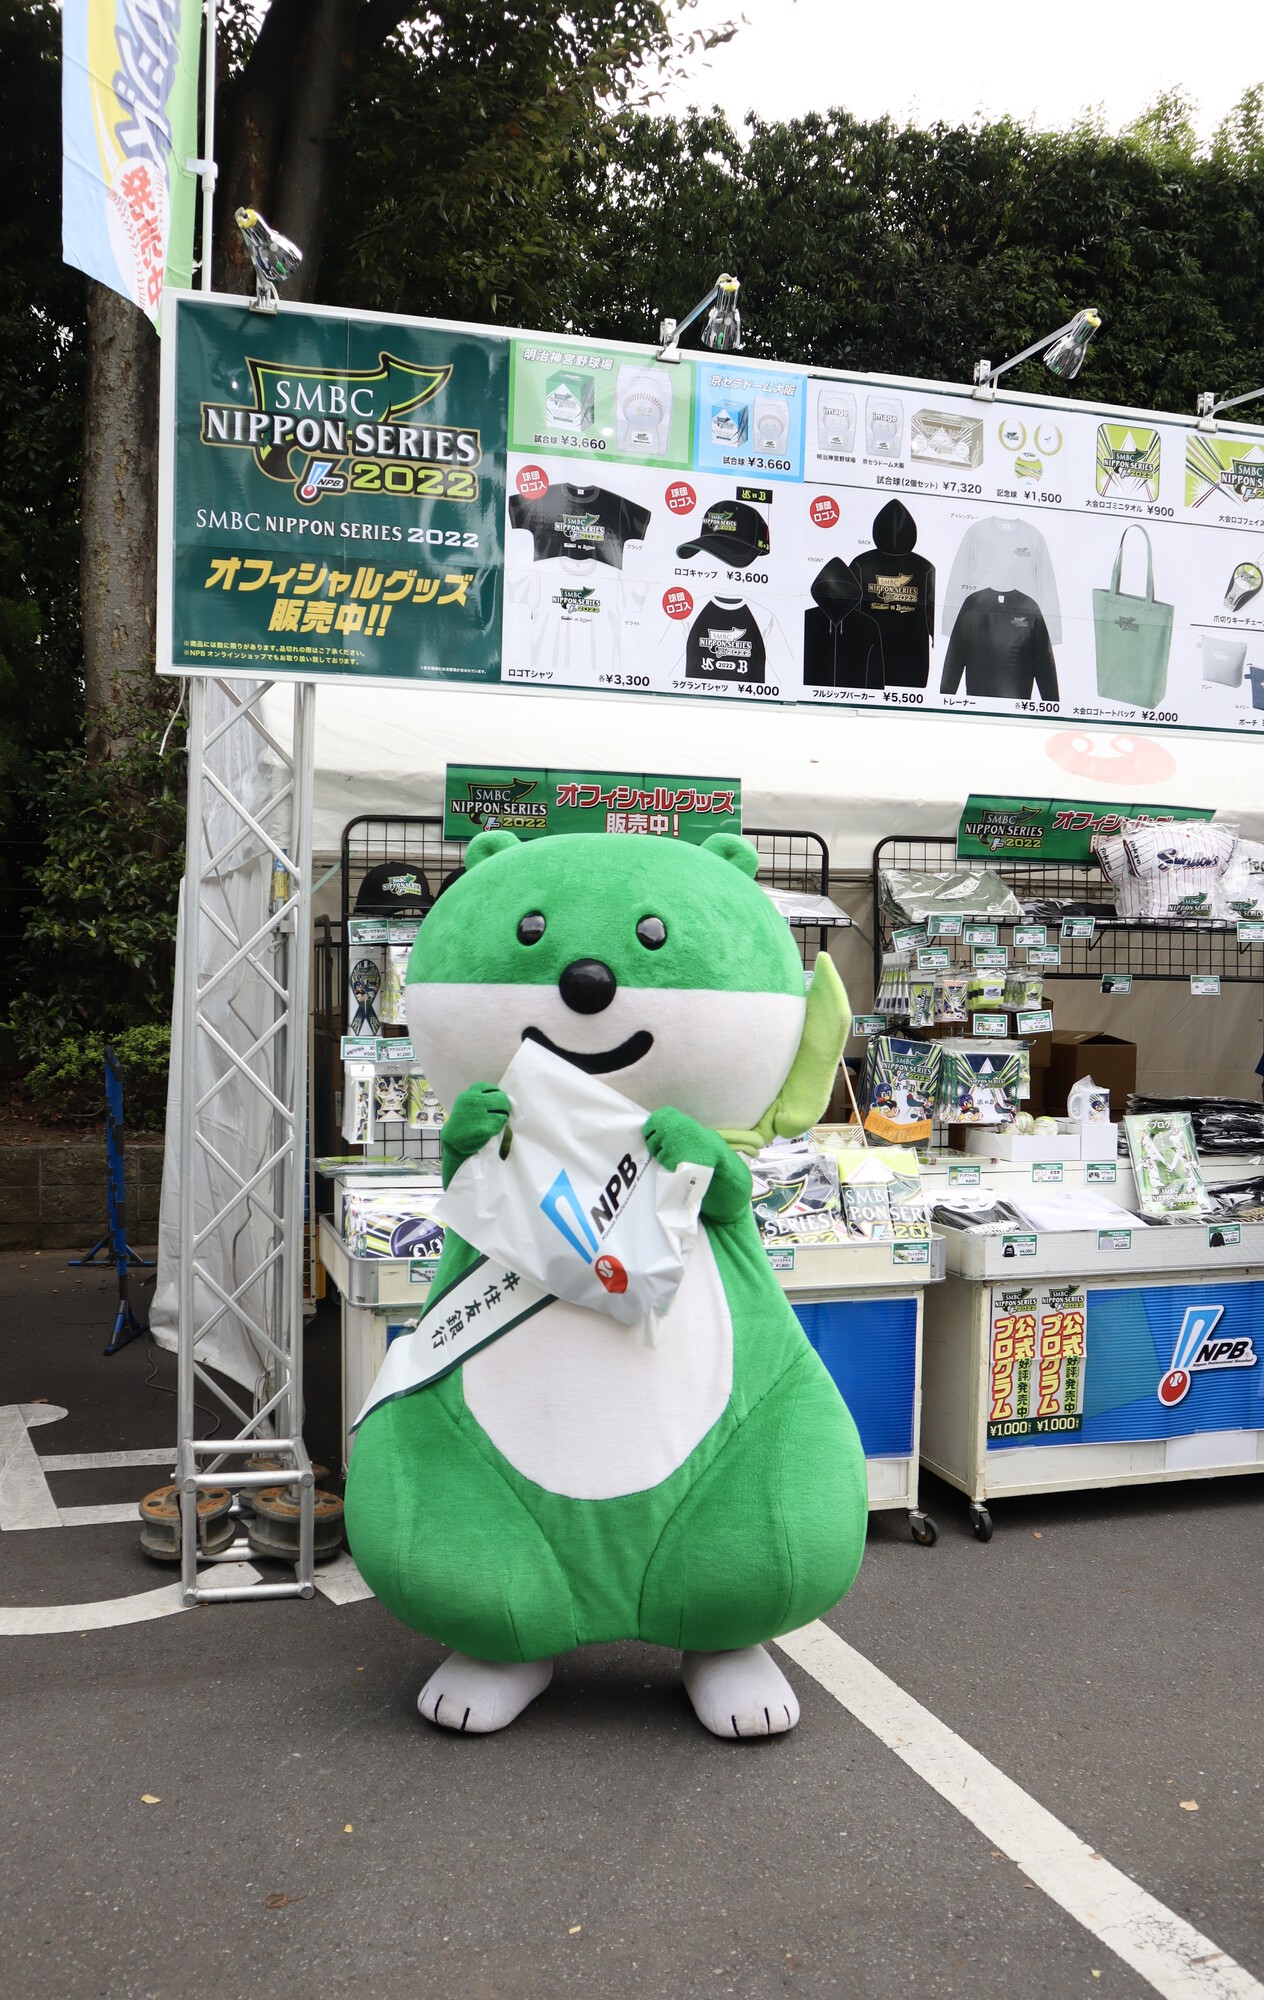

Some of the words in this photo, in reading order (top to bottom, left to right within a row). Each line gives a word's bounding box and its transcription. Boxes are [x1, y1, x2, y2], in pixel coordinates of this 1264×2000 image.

[523, 348, 614, 371] 明治神宮野球場
[710, 375, 797, 396] 京セラドーム大阪
[275, 381, 374, 417] SMBC
[207, 408, 345, 450] NIPPON
[355, 424, 475, 462] SERIES
[534, 434, 558, 444] 試合球
[561, 435, 606, 450] ¥3,660
[723, 456, 745, 466] 試合球
[748, 457, 791, 471] ¥3,660
[816, 454, 856, 463] 明治神宮野球場
[862, 458, 904, 469] 京セラドーム大阪
[1104, 458, 1130, 468] NIPPON
[1130, 462, 1153, 471] SERIES
[1116, 453, 1135, 461] SMBC
[521, 470, 540, 482] 球団
[1238, 464, 1263, 477] SMBC
[317, 478, 341, 488] NPB
[353, 463, 474, 497] 2022
[876, 475, 939, 490] 試合球(2個セット)
[942, 481, 982, 494] ¥7,320
[1221, 472, 1256, 485] NIPPON
[520, 480, 547, 493] ロゴ入
[671, 487, 688, 498] 球団
[669, 497, 694, 509] ロゴ入
[996, 488, 1017, 498] 記念球
[1024, 491, 1062, 503] ¥1,500
[815, 501, 832, 511] 球団
[1085, 500, 1142, 513] 大会ロゴミニタオル
[1147, 505, 1174, 517] ¥900
[814, 510, 838, 522] ロゴ入
[196, 509, 260, 532] SMBC
[266, 516, 335, 537] NIPPON
[340, 522, 402, 541] SERIES
[407, 527, 479, 548] 2022
[555, 523, 581, 532] NIPPON
[581, 525, 604, 533] SERIES
[205, 557, 474, 607] オフィシャルグッズ
[674, 567, 718, 579] ロゴキャップ
[726, 571, 769, 584] ¥3,600
[869, 585, 893, 593] NIPPON
[552, 596, 577, 604] NIPPON
[577, 599, 600, 607] SERIES
[668, 592, 685, 602] 球団
[666, 602, 692, 614] ロゴ入
[268, 598, 393, 637] 販売中!!
[700, 639, 726, 648] NIPPON
[726, 641, 751, 650] SERIES
[508, 668, 553, 679] ロゴTシャツ
[737, 659, 748, 674] B
[672, 680, 728, 692] ラグランTシャツ
[737, 684, 779, 696] ¥4,000
[812, 689, 875, 700] フルジップパーカー
[883, 692, 923, 704] ¥5,500
[943, 697, 976, 706] トレーナー
[1073, 707, 1136, 718] 大会ロゴトートバッグ
[1142, 710, 1178, 722] ¥2,000
[476, 789, 511, 801] SMBC
[557, 783, 735, 814] オフィシャルグッズ
[452, 801, 500, 814] NIPPON
[503, 803, 547, 815] SERIES
[502, 817, 546, 828] 2022
[605, 812, 680, 837] 販売中!
[987, 814, 1018, 825] SMBC
[965, 823, 1005, 835] NIPPON
[1007, 826, 1043, 837] SERIES
[1006, 839, 1041, 848] 2022
[883, 1062, 908, 1071] NIPPON
[909, 1065, 932, 1075] SERIES
[896, 1057, 915, 1065] SMBC
[907, 1073, 931, 1081] 2022
[590, 1153, 638, 1235] NPB
[845, 1188, 895, 1204] SMBC
[764, 1213, 830, 1236] SERIES
[1014, 1315, 1036, 1361] 公式
[1062, 1312, 1084, 1358] 公式
[1195, 1341, 1249, 1363] NPB
[990, 1315, 1016, 1420] プログラム
[1037, 1312, 1063, 1417] プログラム
[1017, 1358, 1031, 1418] 好評発売中
[1064, 1355, 1079, 1415] 好評発売中
[990, 1421, 1028, 1436] ¥1,000
[1037, 1417, 1075, 1432] ¥1,000
